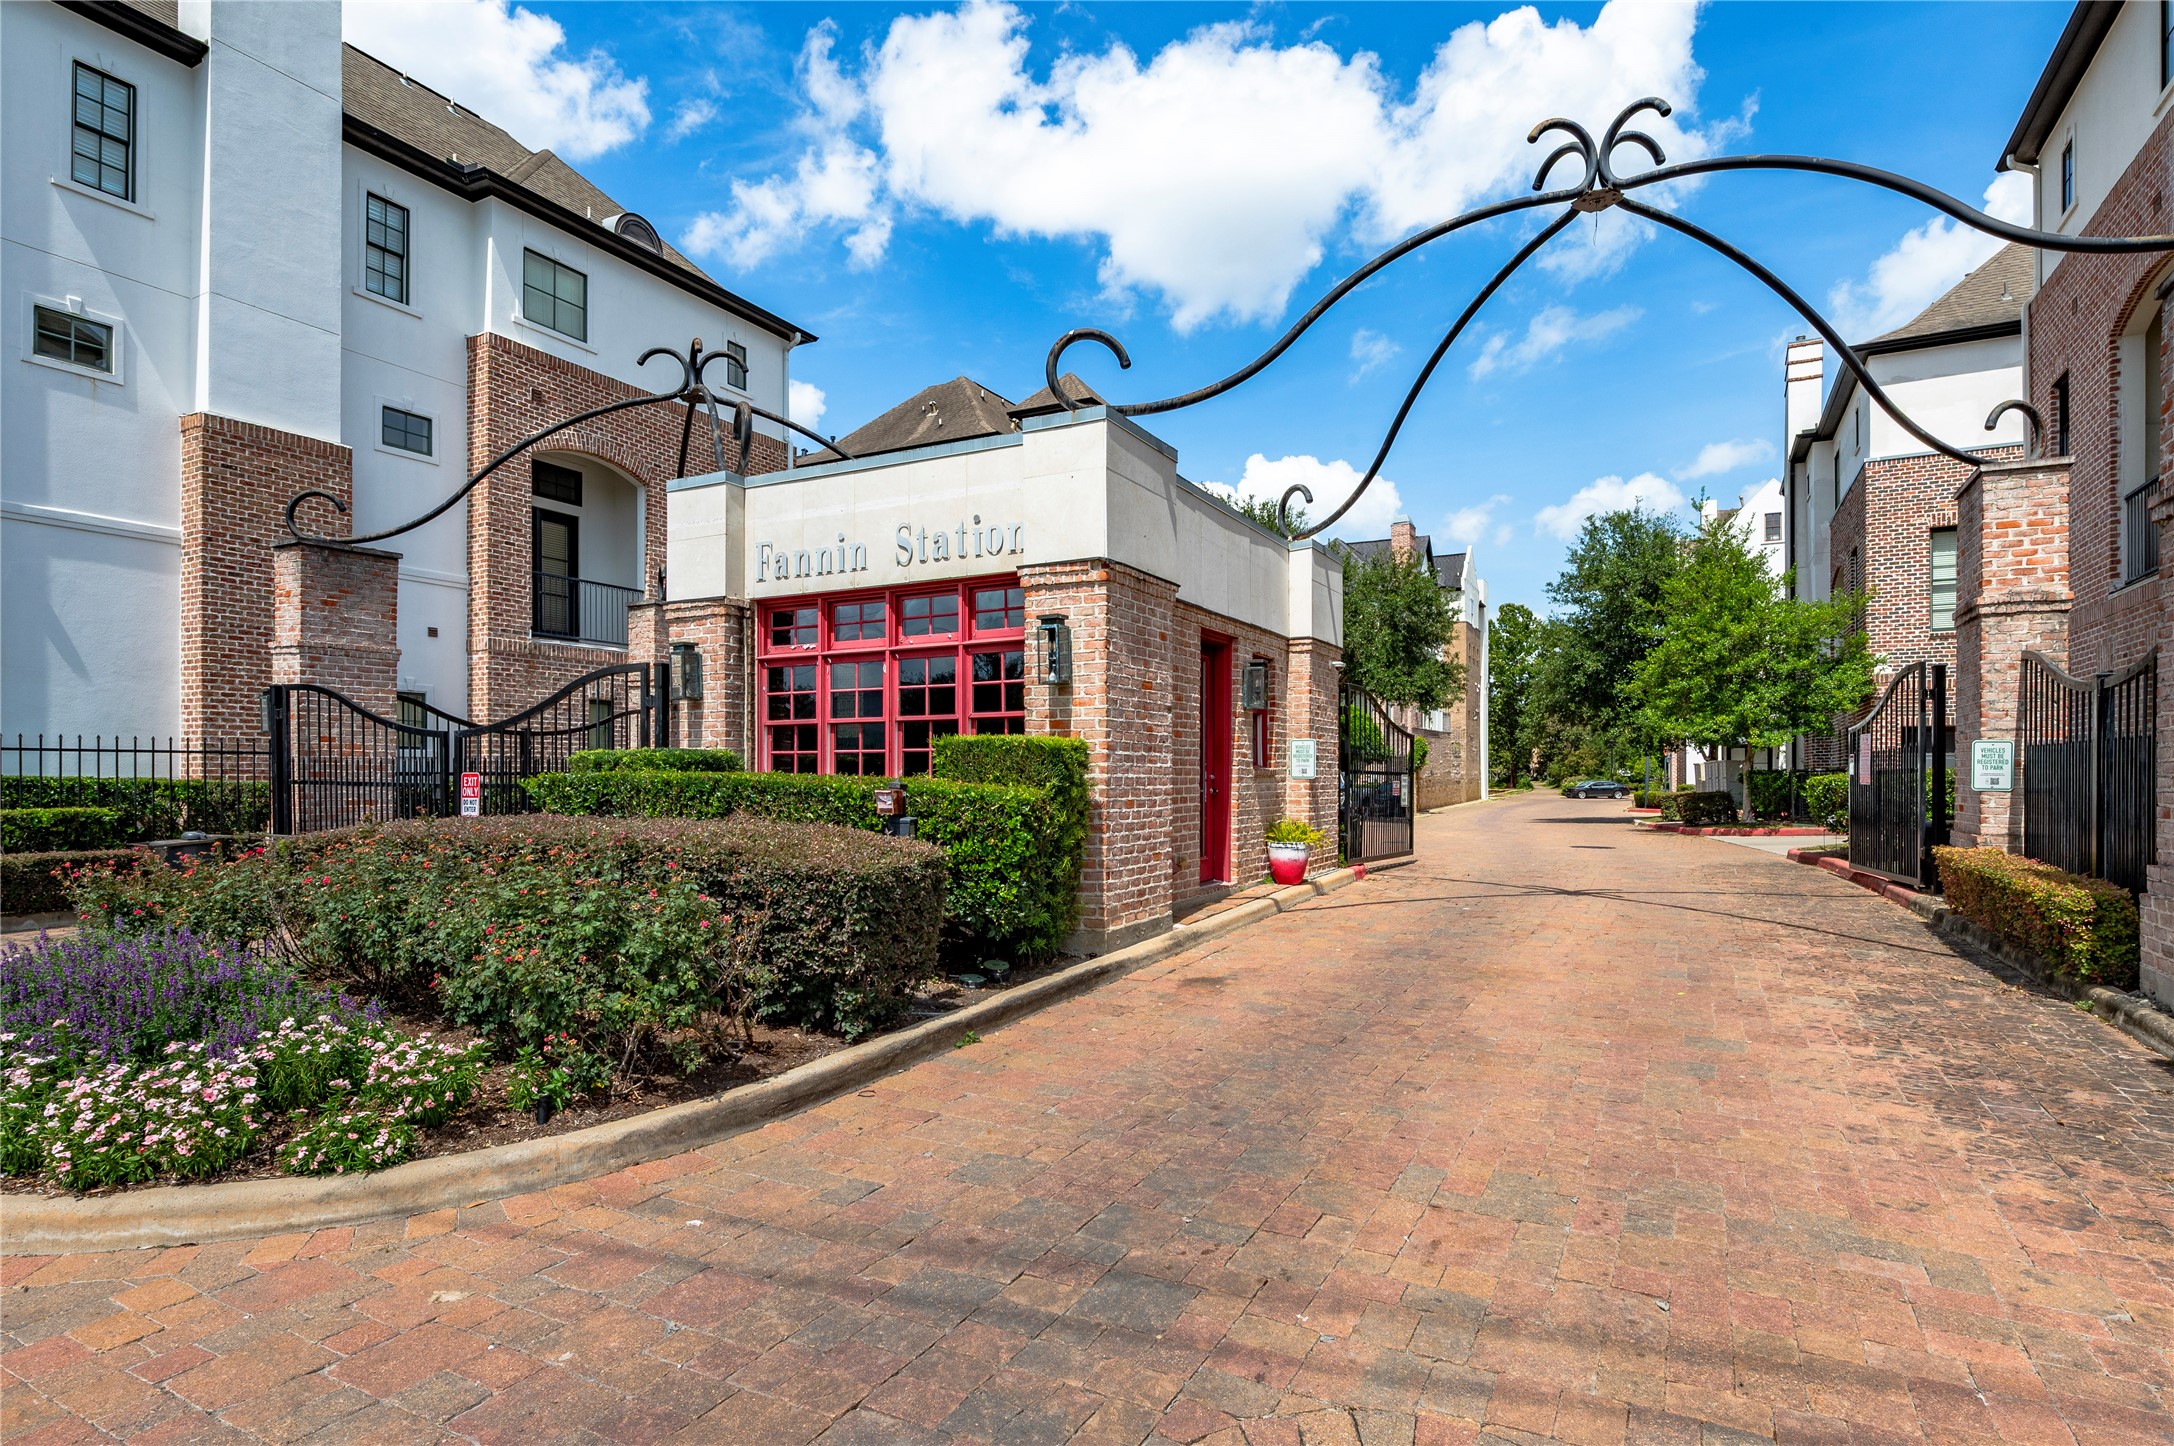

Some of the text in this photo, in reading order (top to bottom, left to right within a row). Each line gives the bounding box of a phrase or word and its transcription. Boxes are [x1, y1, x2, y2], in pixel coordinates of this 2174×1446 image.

[755, 514, 1024, 583] Fannin Station
[464, 777, 477, 786] EXIT
[463, 788, 478, 796] ONLY
